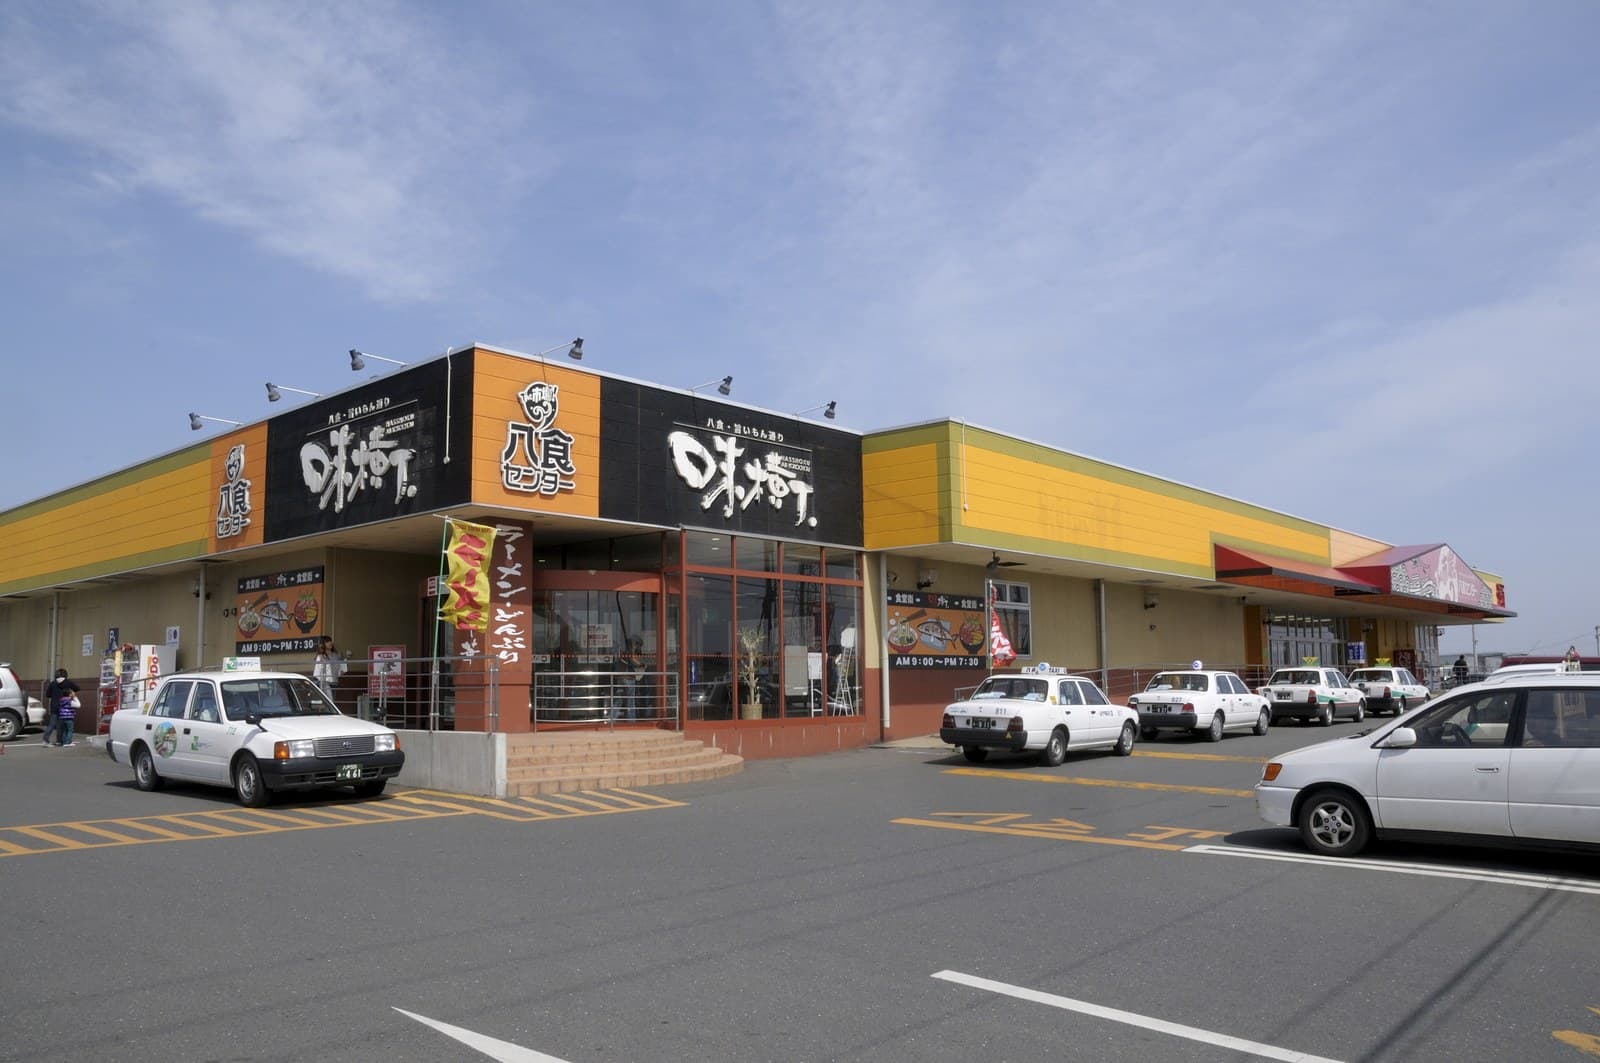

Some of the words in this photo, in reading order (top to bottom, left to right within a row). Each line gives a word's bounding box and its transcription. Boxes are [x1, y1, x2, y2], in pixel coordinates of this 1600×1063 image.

[707, 418, 784, 442] 八食・旨いもん通り
[502, 421, 575, 474] 八食
[501, 462, 576, 495] センター
[217, 479, 251, 516] 八食
[216, 516, 251, 539] センター
